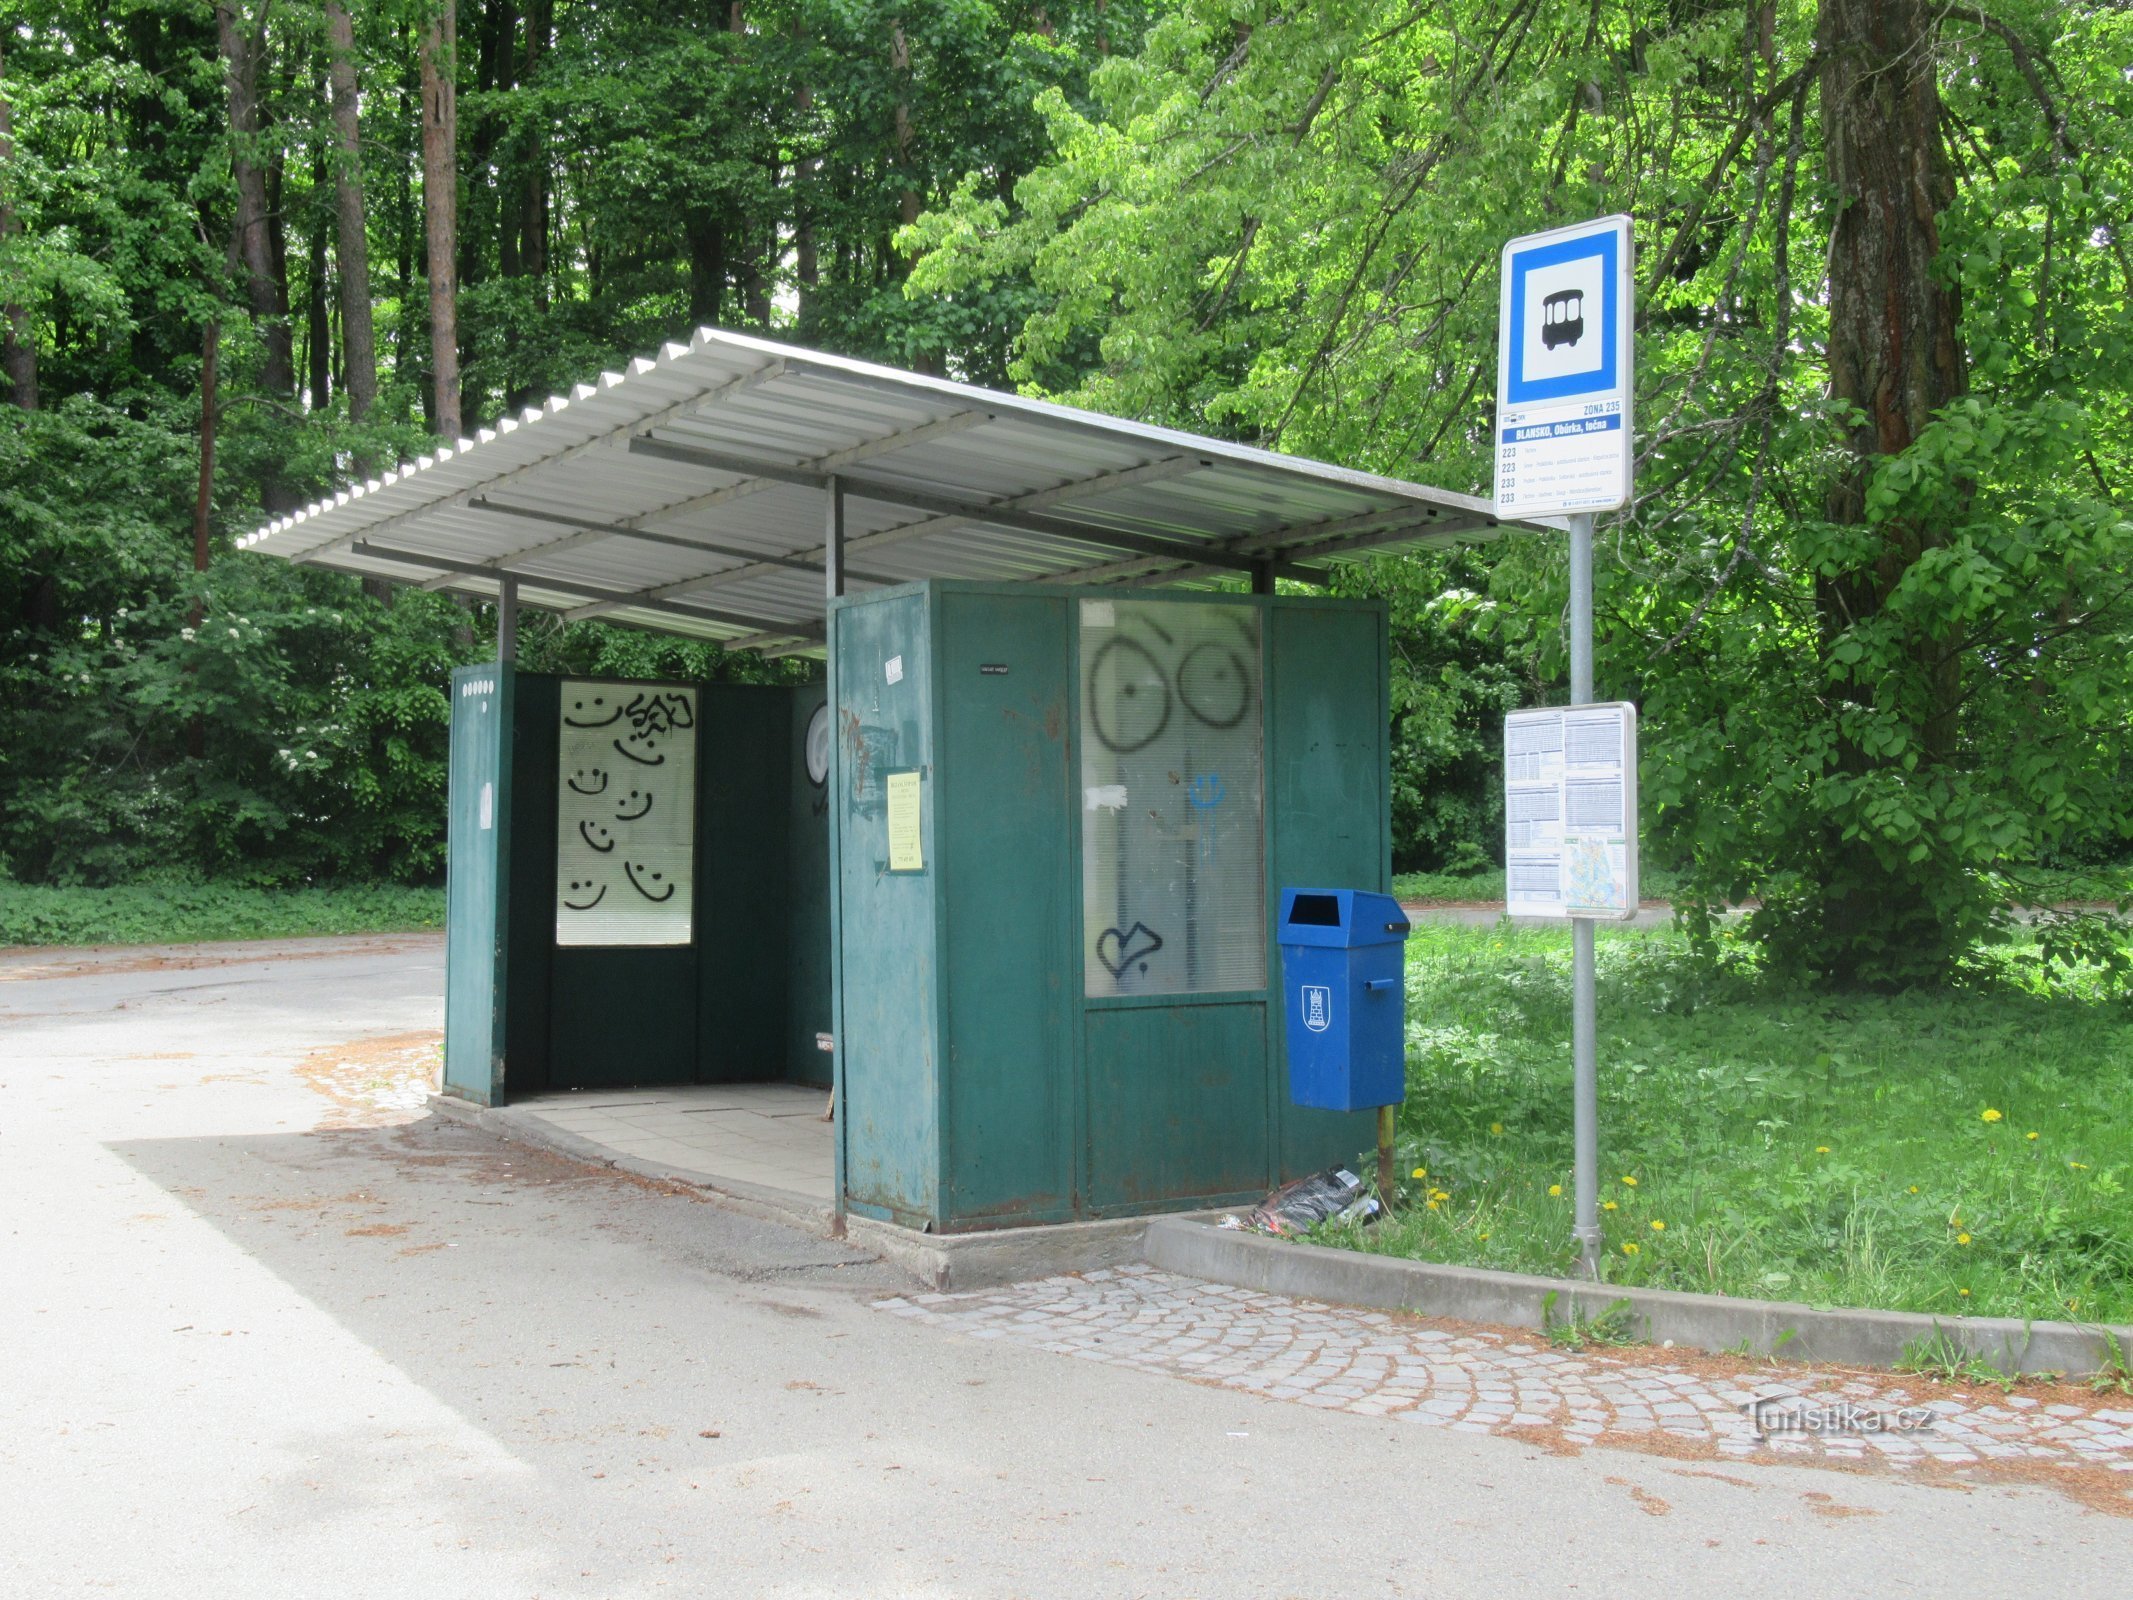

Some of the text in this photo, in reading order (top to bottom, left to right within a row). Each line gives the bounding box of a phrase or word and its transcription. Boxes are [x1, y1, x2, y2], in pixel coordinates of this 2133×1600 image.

[1584, 401, 1620, 415] ZONA 235
[1516, 426, 1552, 440] BLANSKO,
[1585, 419, 1606, 432] točna
[1502, 447, 1516, 458] 223
[1502, 462, 1516, 473] 223
[1501, 478, 1515, 489] 233
[1500, 493, 1515, 503] 233
